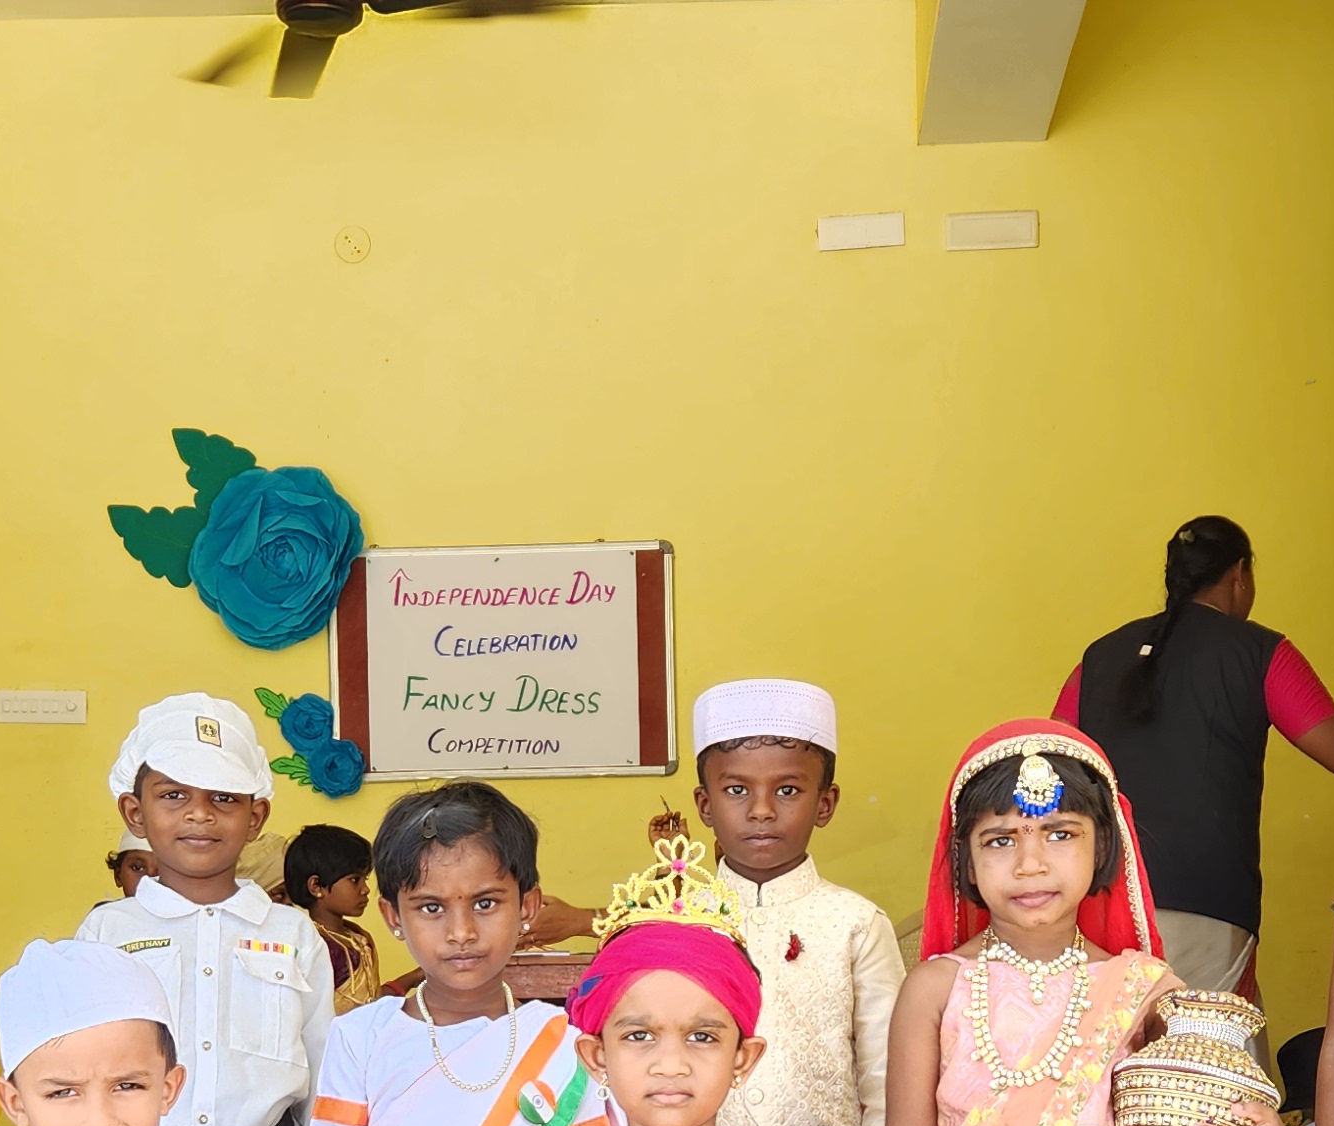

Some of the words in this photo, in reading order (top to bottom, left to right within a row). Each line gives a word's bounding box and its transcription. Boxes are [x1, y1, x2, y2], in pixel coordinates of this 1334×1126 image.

[388, 568, 562, 607] INDEPENDENCE
[565, 570, 616, 605] DAY
[434, 625, 578, 658] CELEBRATION
[403, 675, 496, 712] FANCY
[506, 674, 602, 715] DRESS
[428, 728, 560, 755] COMPETITION
